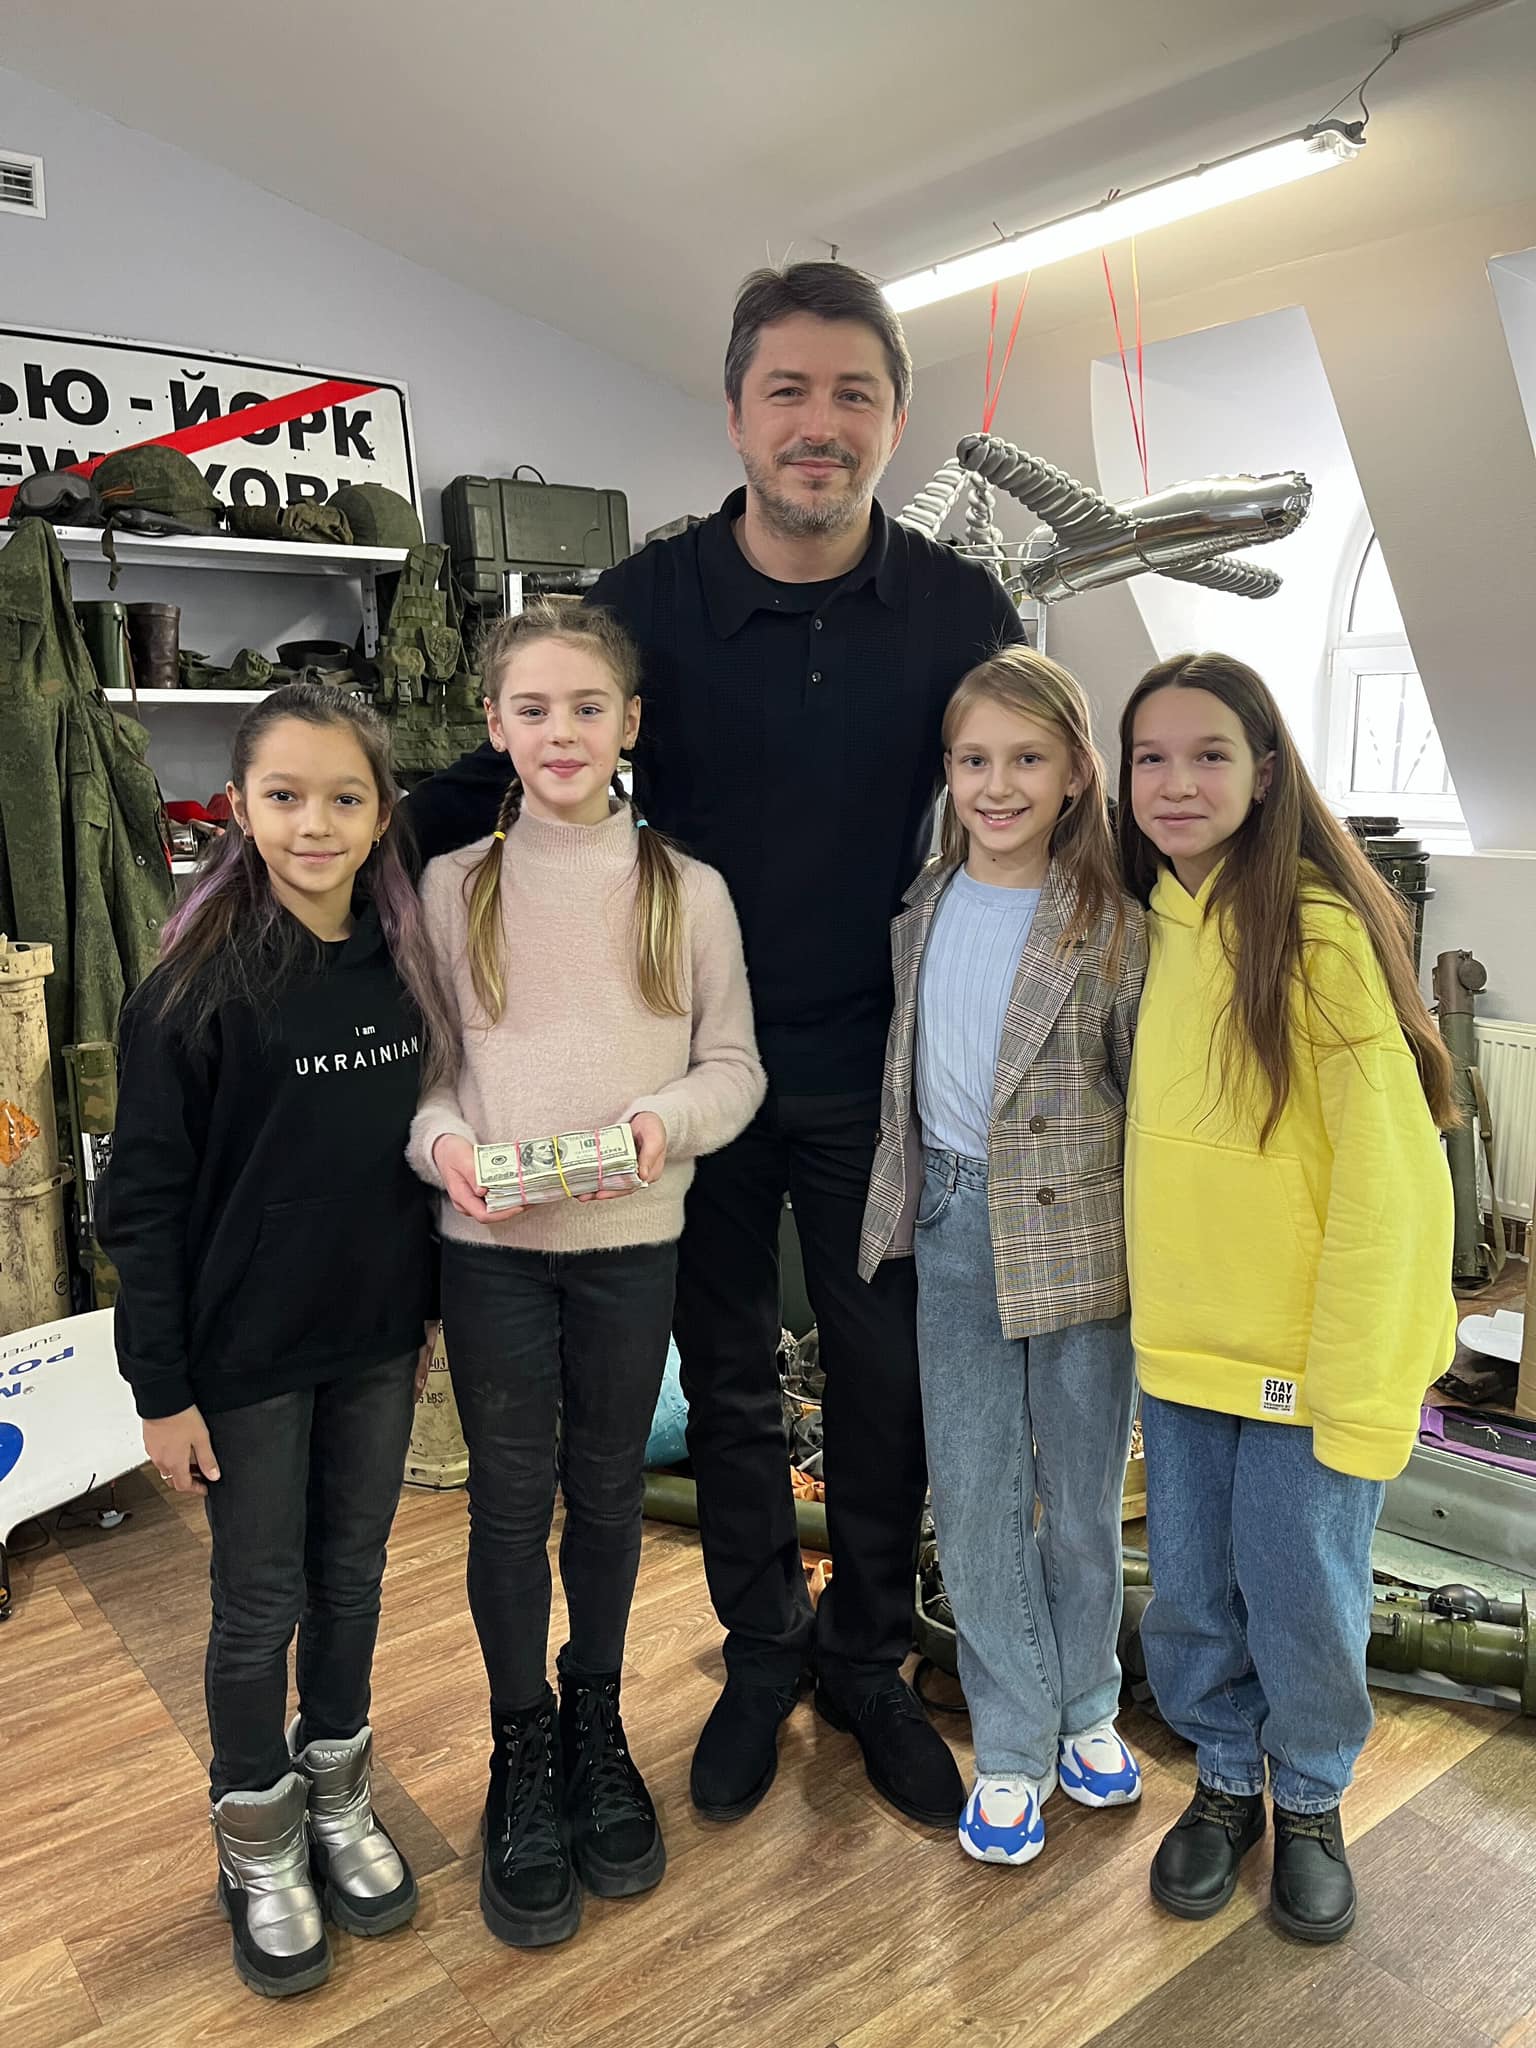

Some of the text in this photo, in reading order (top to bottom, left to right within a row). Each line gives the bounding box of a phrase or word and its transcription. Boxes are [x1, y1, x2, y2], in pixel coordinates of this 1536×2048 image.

[362, 1025, 376, 1036] am
[295, 1036, 419, 1075] UKRAINIAN
[1265, 1379, 1293, 1394] STAY
[1264, 1391, 1292, 1404] TORY
